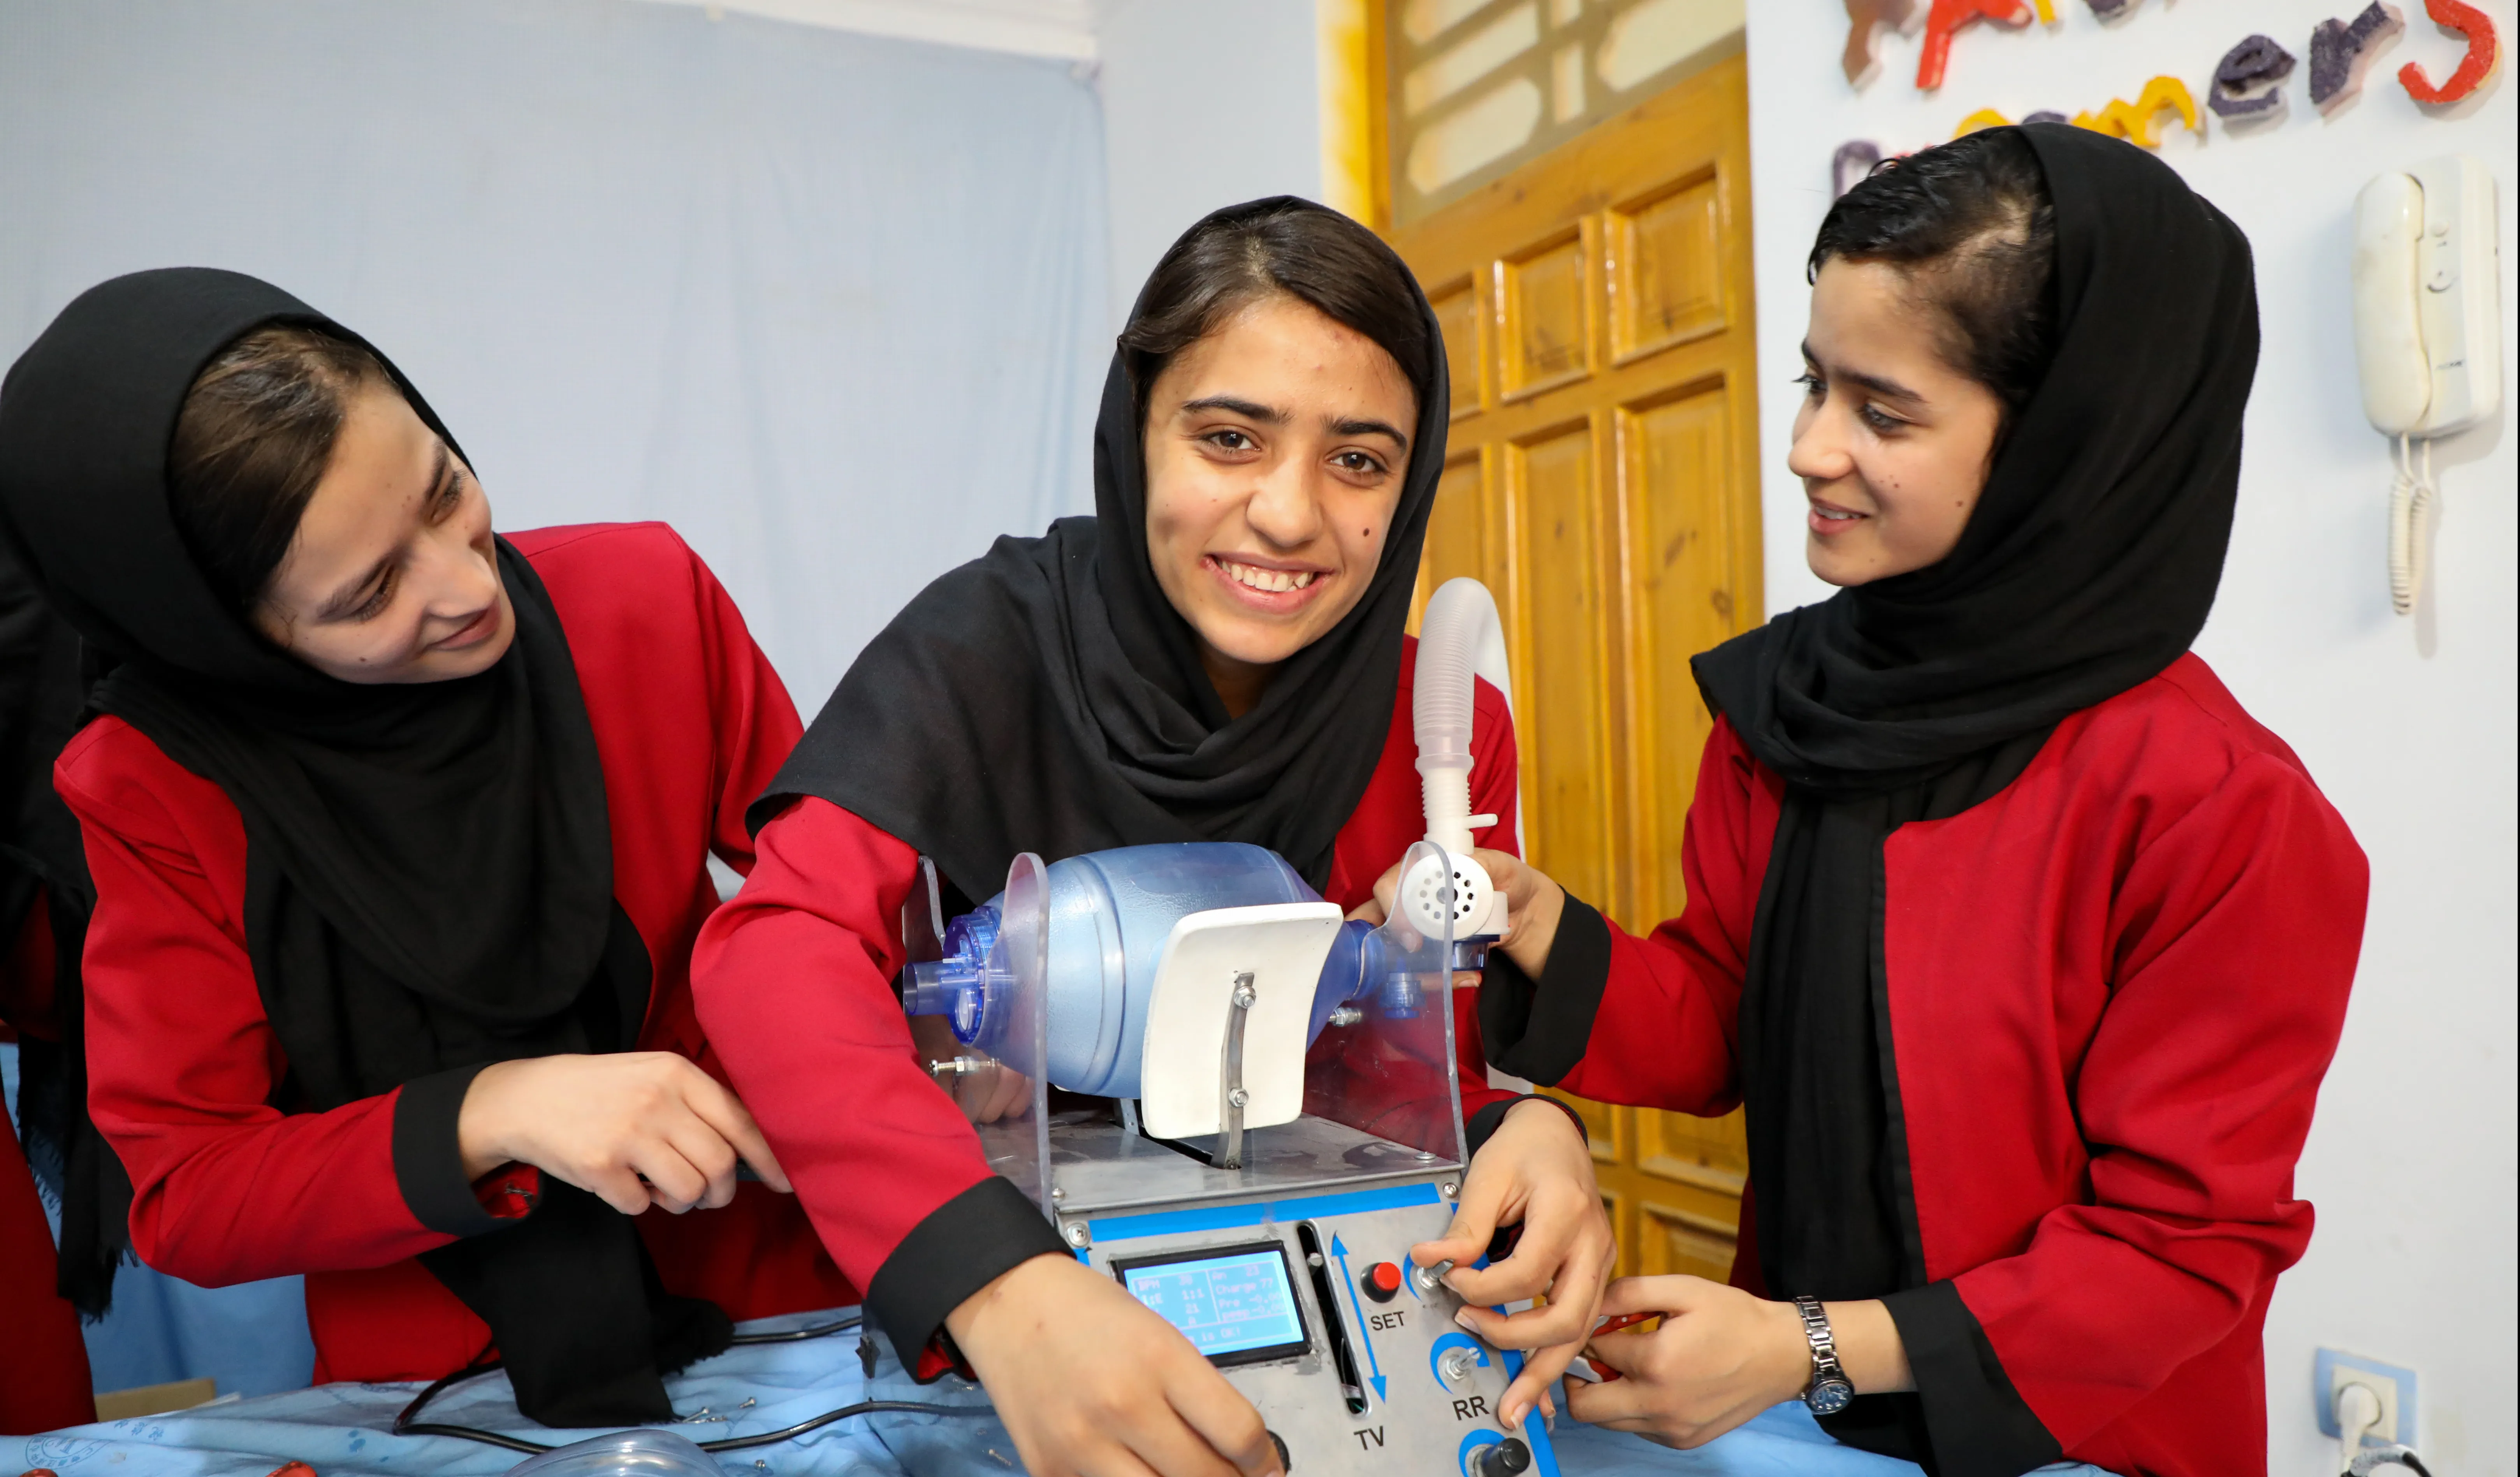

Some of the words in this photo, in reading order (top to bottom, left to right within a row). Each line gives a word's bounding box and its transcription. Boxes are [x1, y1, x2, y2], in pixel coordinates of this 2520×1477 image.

[1182, 1289, 1205, 1301] 1:1
[1215, 1282, 1257, 1295] Charge
[1218, 1298, 1240, 1309] Pre
[1370, 1311, 1404, 1331] SET
[1201, 1330, 1215, 1342] is
[1221, 1327, 1240, 1338] OK!
[1453, 1396, 1489, 1421] RR
[1353, 1426, 1384, 1451] TV
